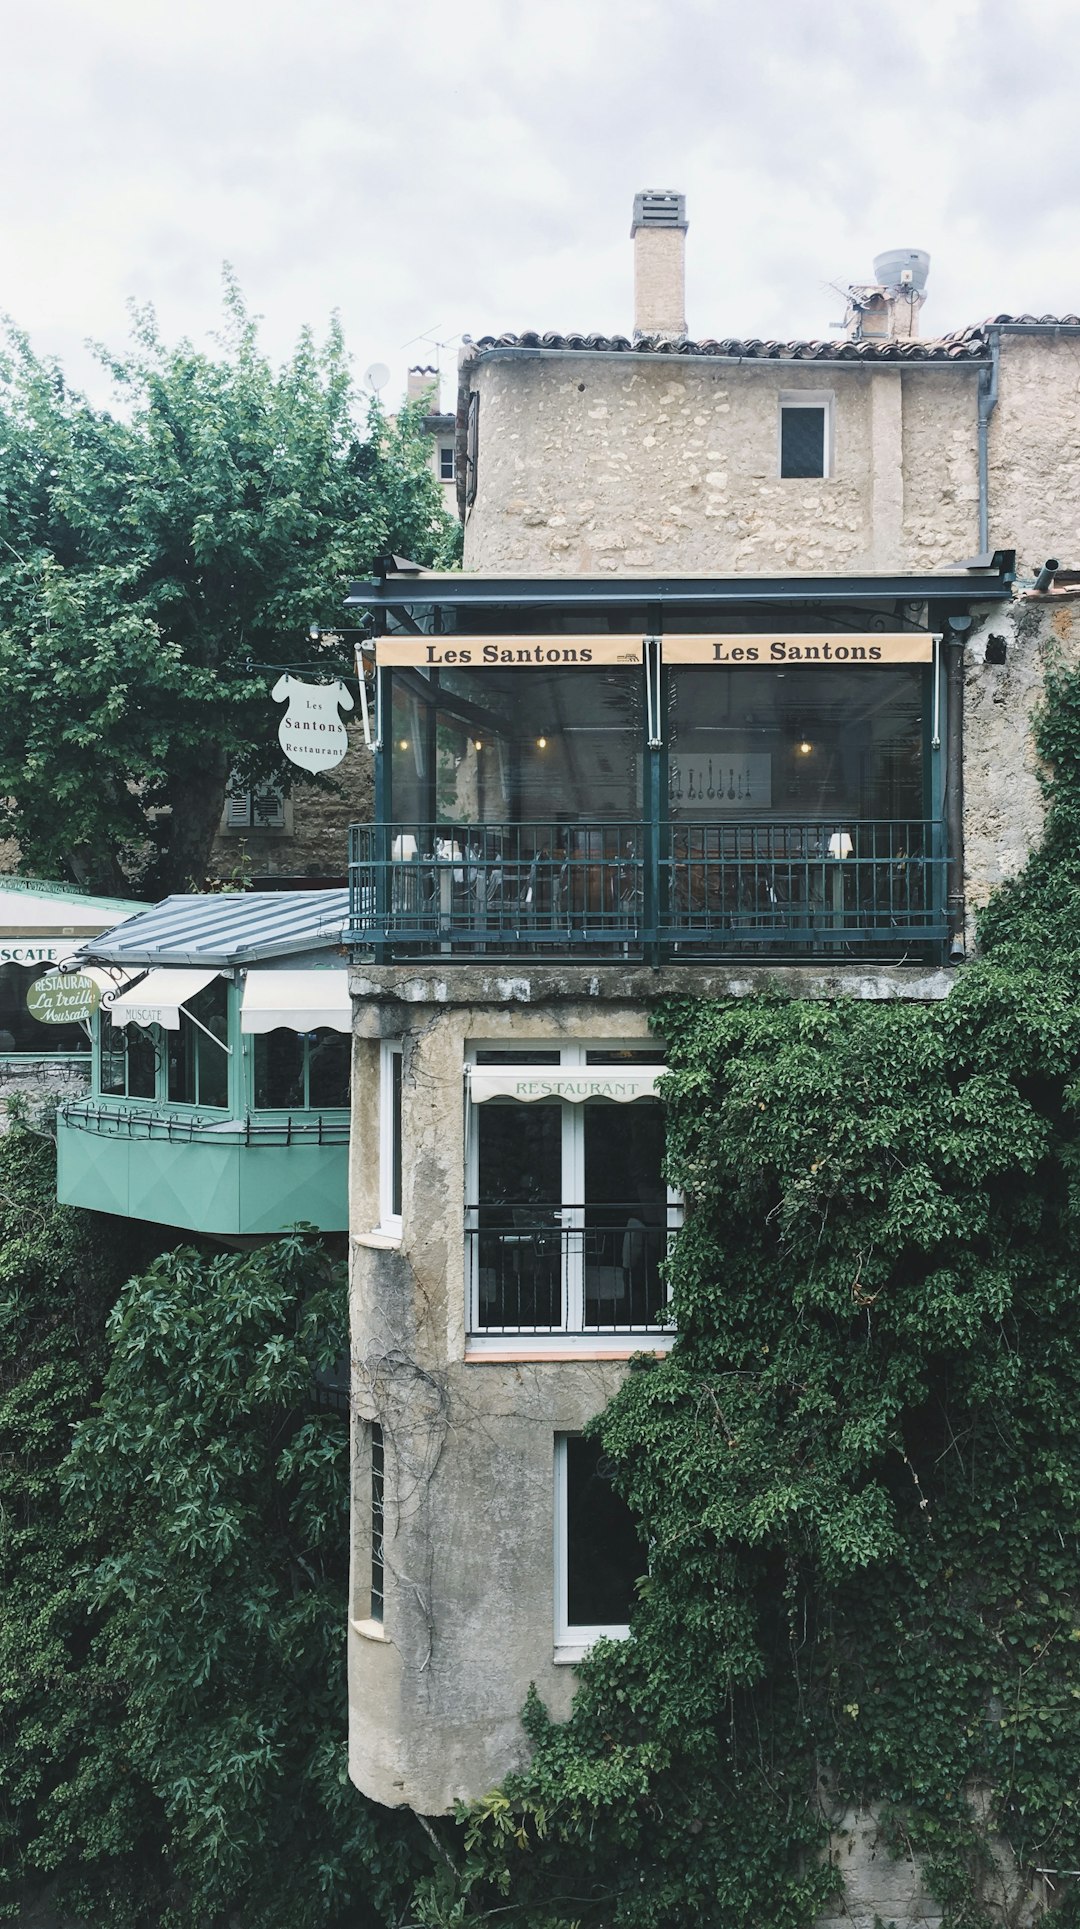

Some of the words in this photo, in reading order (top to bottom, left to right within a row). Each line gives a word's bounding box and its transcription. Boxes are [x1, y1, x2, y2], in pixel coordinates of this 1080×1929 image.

[426, 645, 472, 663] Les
[482, 644, 593, 663] Santons
[712, 643, 759, 661] Les
[770, 642, 882, 661] Santons
[306, 700, 322, 710] Les
[285, 718, 343, 733] Santons
[286, 743, 343, 756] Restaurant
[35, 975, 93, 992] RESTAURANT
[28, 992, 53, 1010] La
[55, 989, 96, 1008] treille
[40, 1005, 90, 1022] Muscate
[125, 1008, 162, 1021] MUSCATE
[516, 1082, 640, 1095] RESTAURANT
